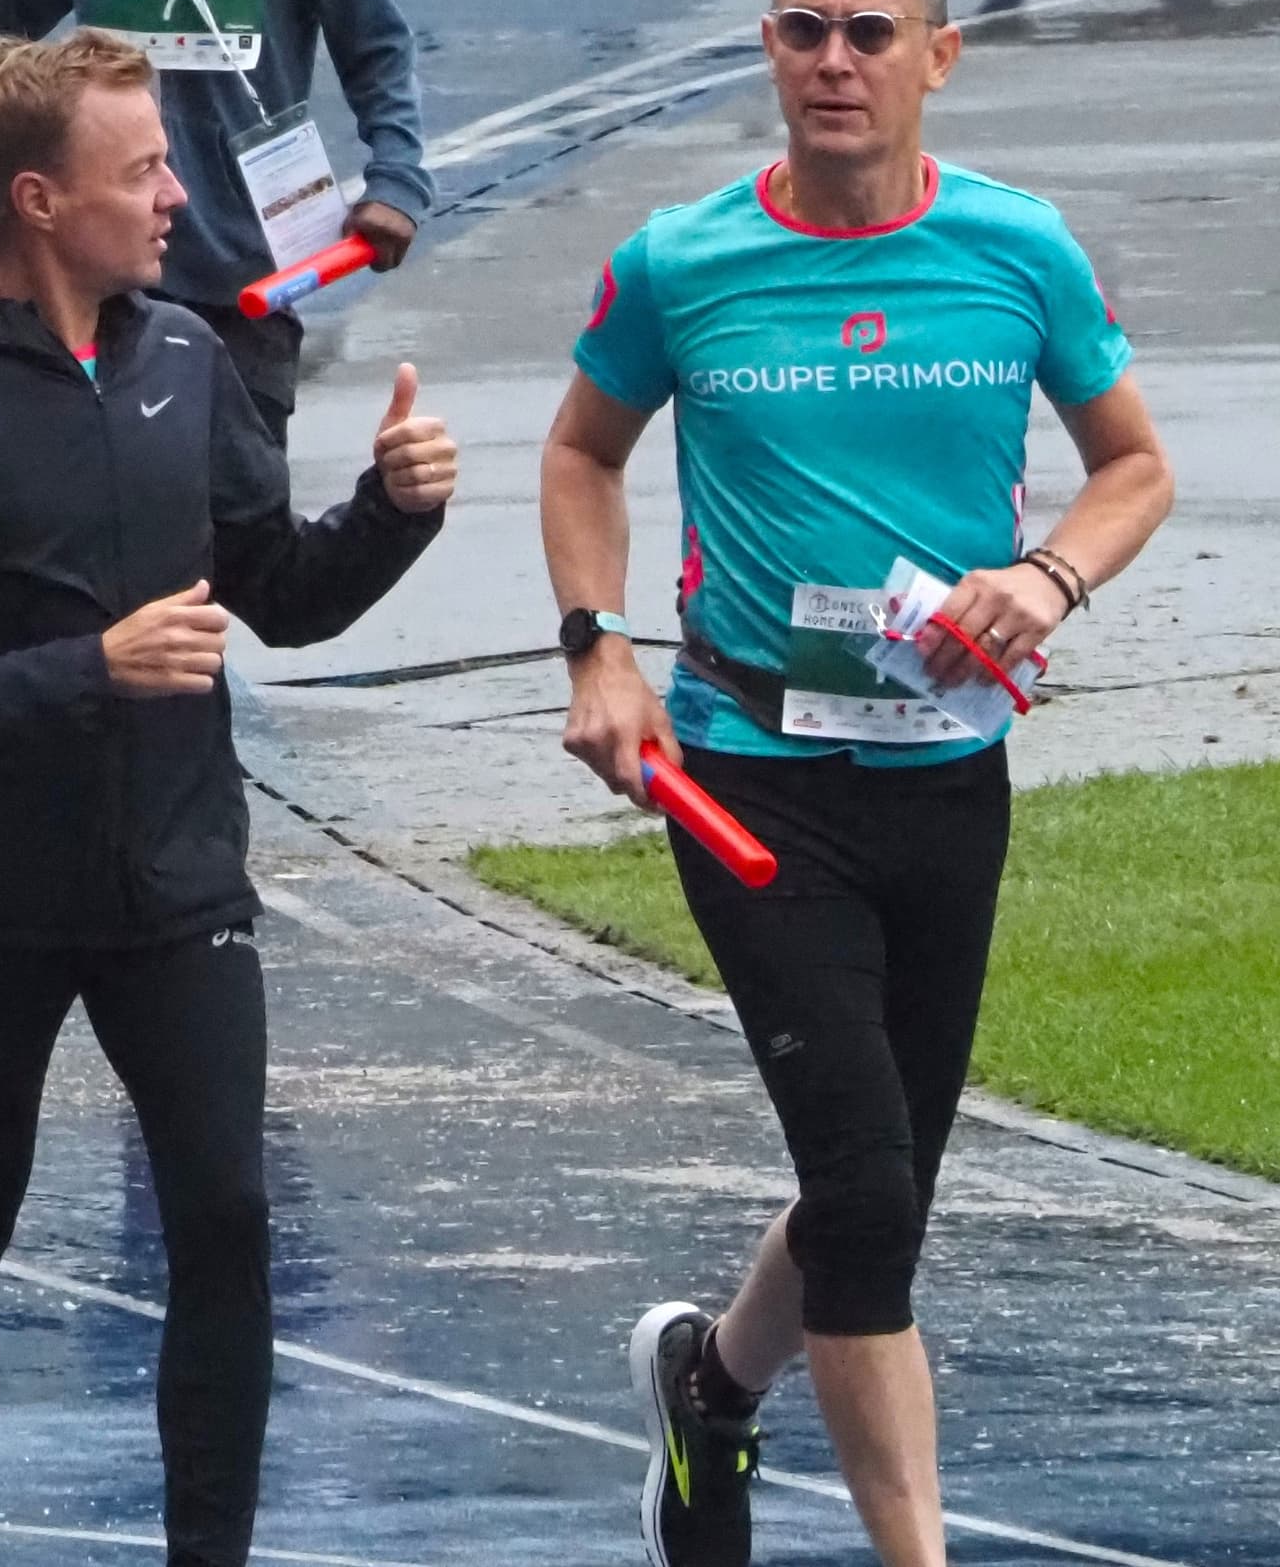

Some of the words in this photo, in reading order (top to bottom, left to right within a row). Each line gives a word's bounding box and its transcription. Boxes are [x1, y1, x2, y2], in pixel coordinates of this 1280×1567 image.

[690, 365, 837, 395] GROUPE
[848, 360, 1028, 390] PRIMONIAL
[803, 614, 835, 628] HOME
